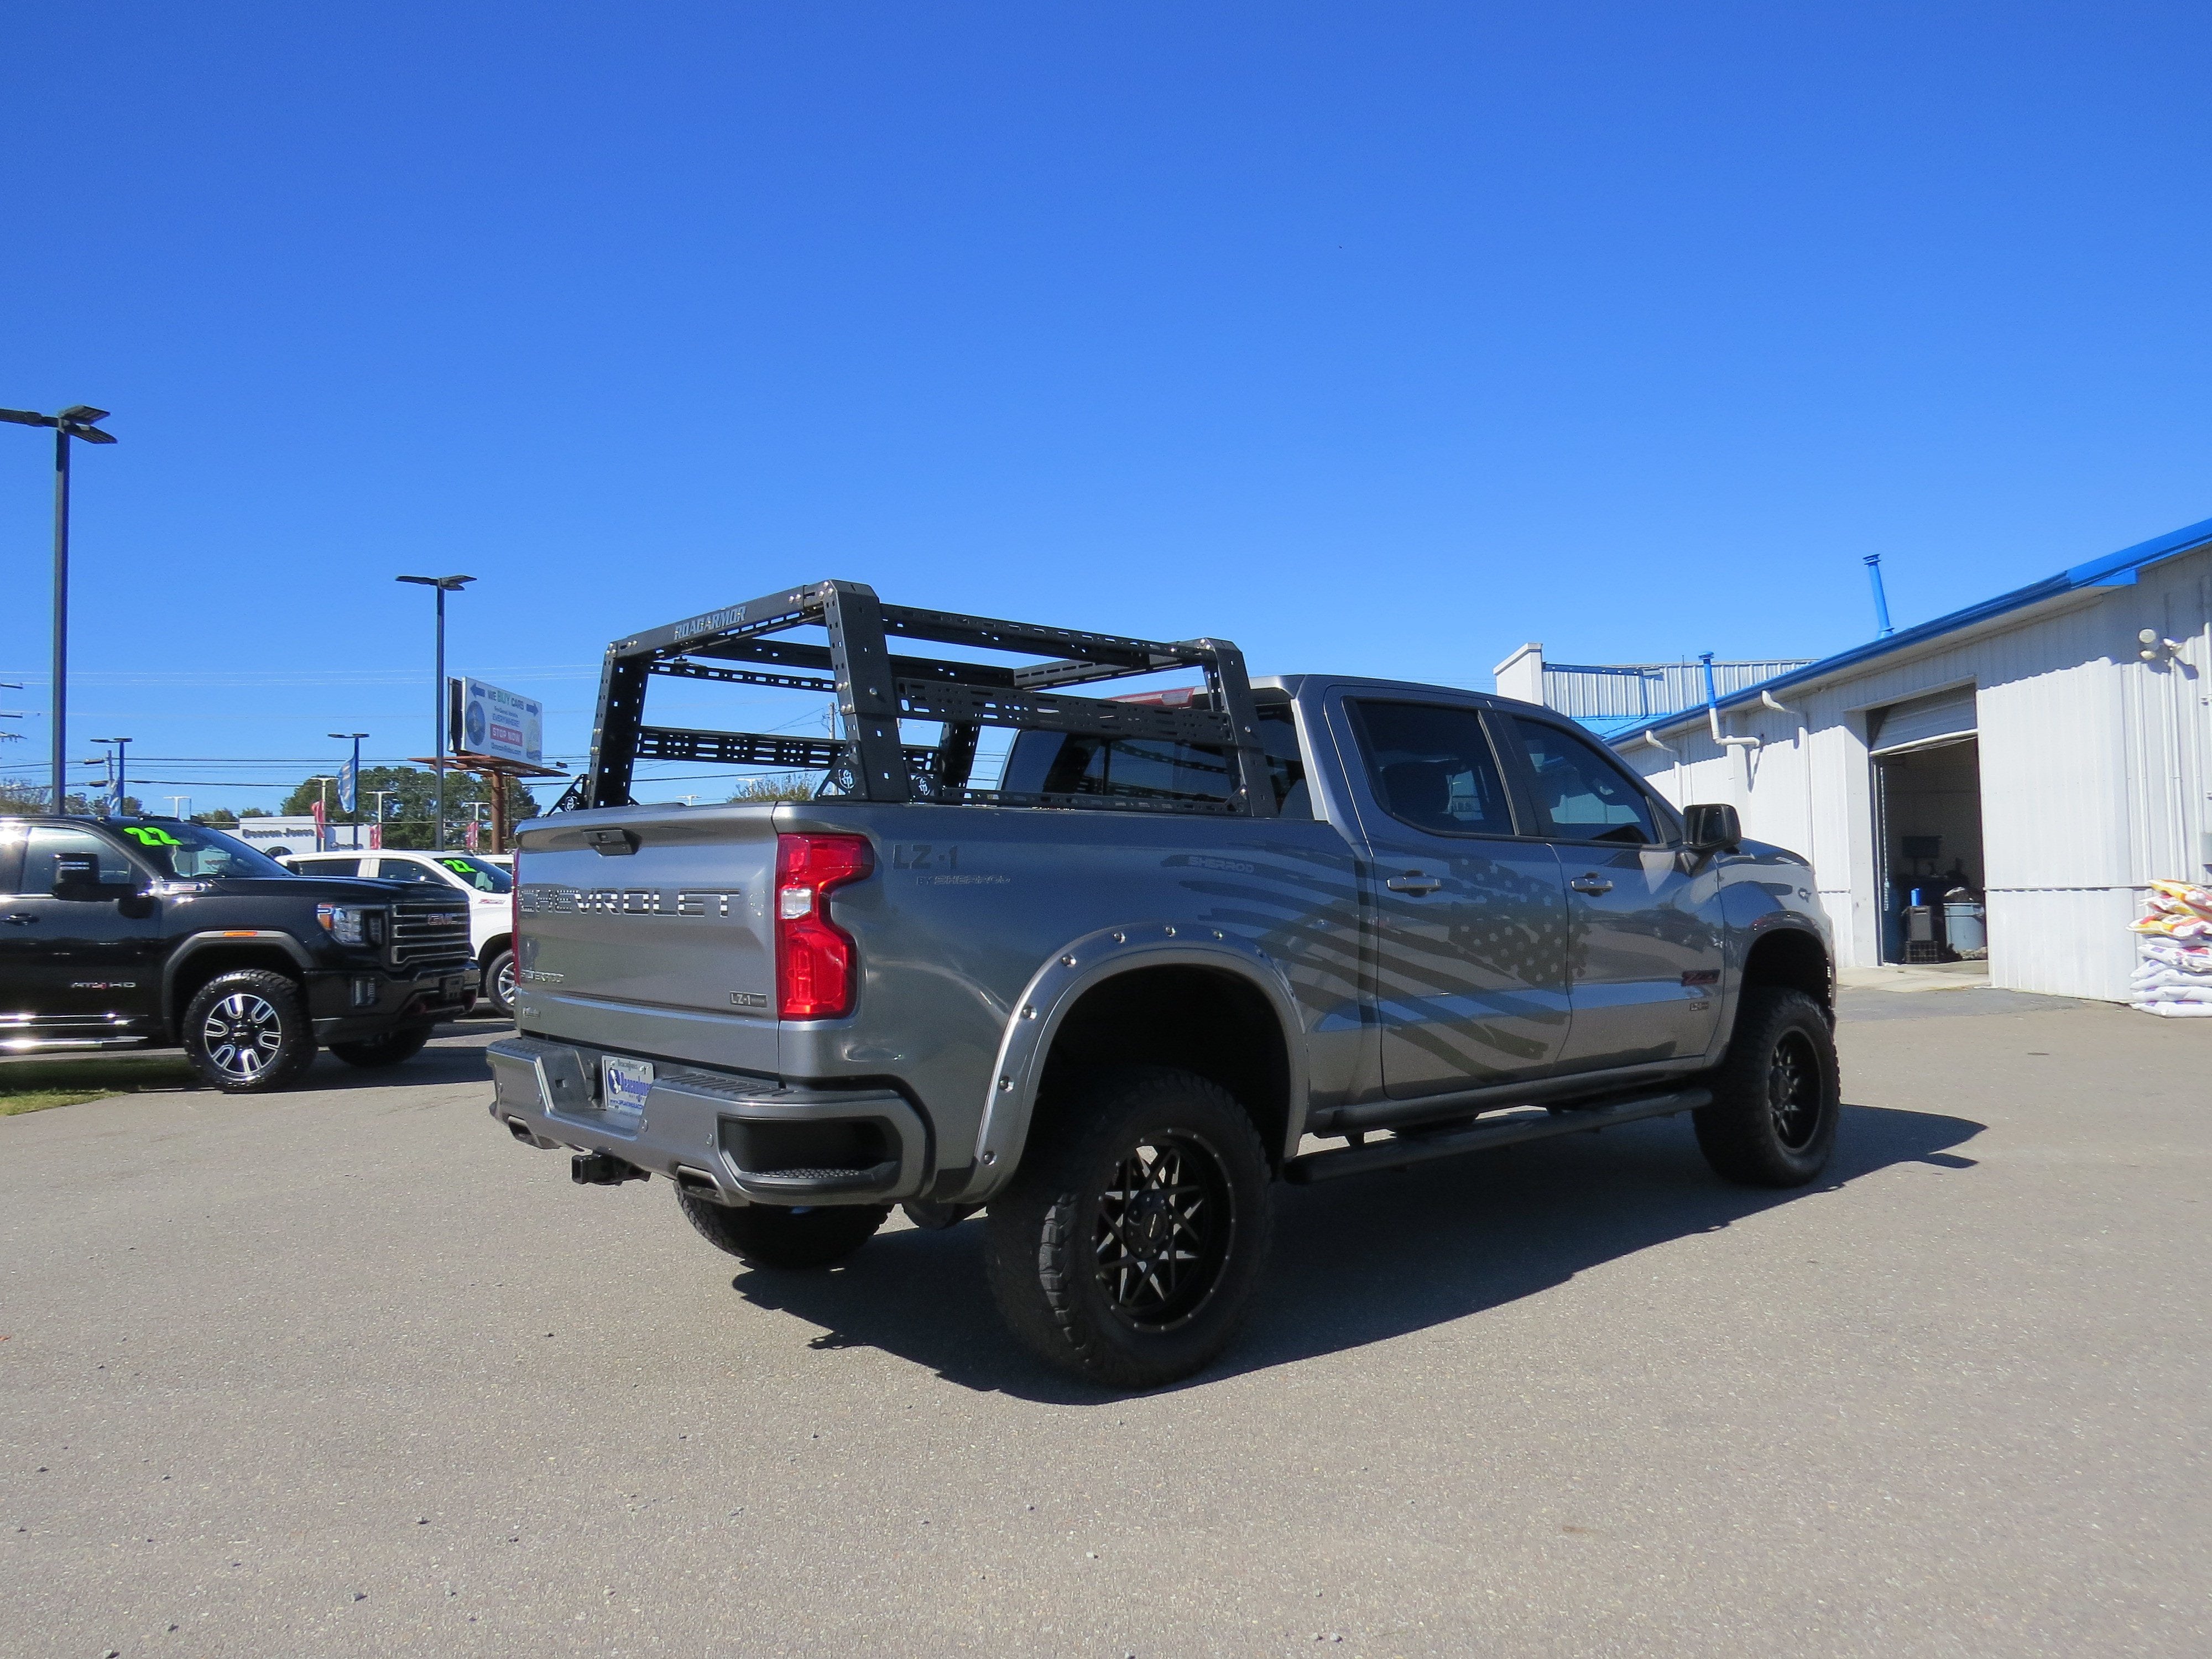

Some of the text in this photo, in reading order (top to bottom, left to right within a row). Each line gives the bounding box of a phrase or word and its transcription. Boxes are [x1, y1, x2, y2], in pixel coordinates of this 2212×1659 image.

[497, 690, 510, 706] BUY
[511, 698, 524, 710] CARS
[492, 727, 507, 738] STOP
[123, 827, 183, 846] 22
[444, 859, 477, 873] 22
[916, 876, 932, 885] BY
[518, 887, 740, 919] CHEVROLET
